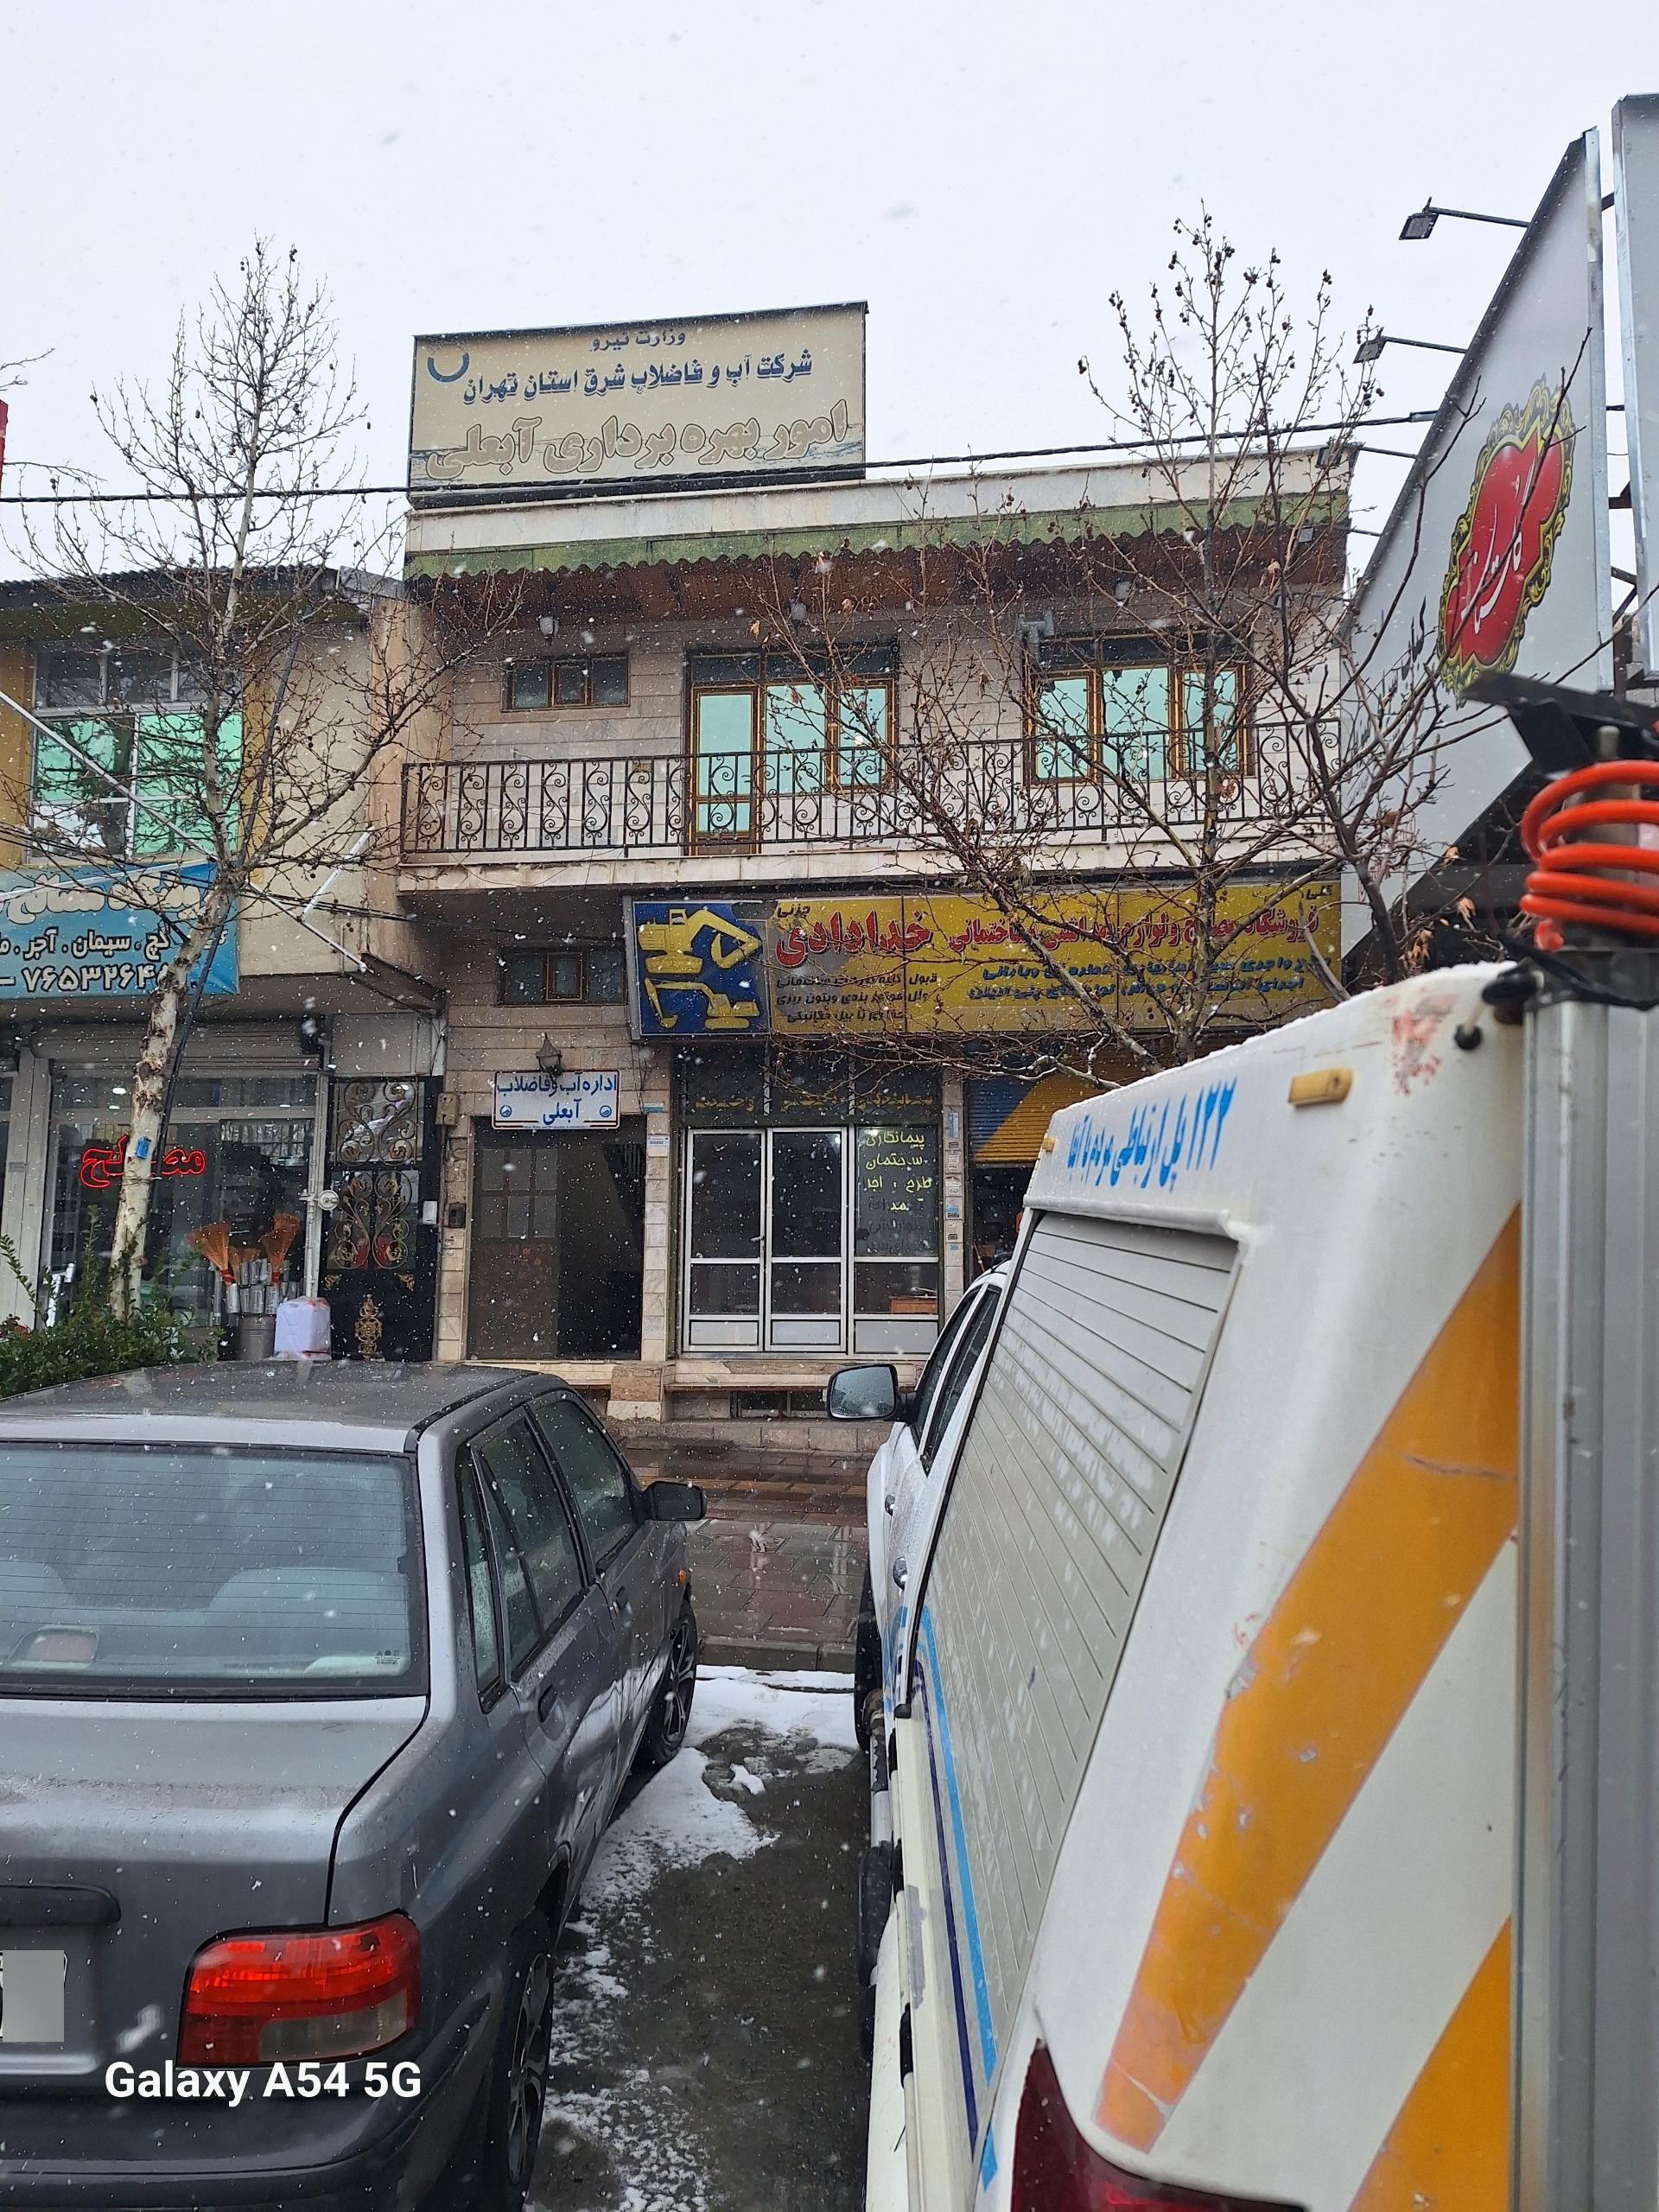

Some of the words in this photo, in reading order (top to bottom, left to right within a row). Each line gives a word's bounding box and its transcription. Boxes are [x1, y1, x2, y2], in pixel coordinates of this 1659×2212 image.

[589, 332, 631, 352] نیرو
[635, 329, 687, 347] وزارت
[630, 359, 704, 394] فاضلاب
[707, 366, 722, 389] و
[725, 354, 752, 383] آب
[755, 347, 814, 378] شرکت
[461, 371, 519, 405] تهران
[523, 369, 579, 403] استان
[583, 362, 626, 397] شرق
[543, 415, 677, 474] برداری
[679, 416, 761, 466] بهره
[762, 398, 850, 461] امور
[426, 416, 543, 480] آبعلی
[22, 926, 59, 961] آجر
[72, 928, 131, 958] سیمان
[909, 973, 938, 985] قبول
[777, 994, 802, 1005] ریزی
[560, 1071, 583, 1095] آب
[582, 1074, 617, 1096] اداره
[542, 1097, 582, 1126] آبعلی
[865, 1130, 925, 1151] پیمانکاری
[79, 1134, 207, 1189] مصلح
[906, 1175, 932, 1193] طرح
